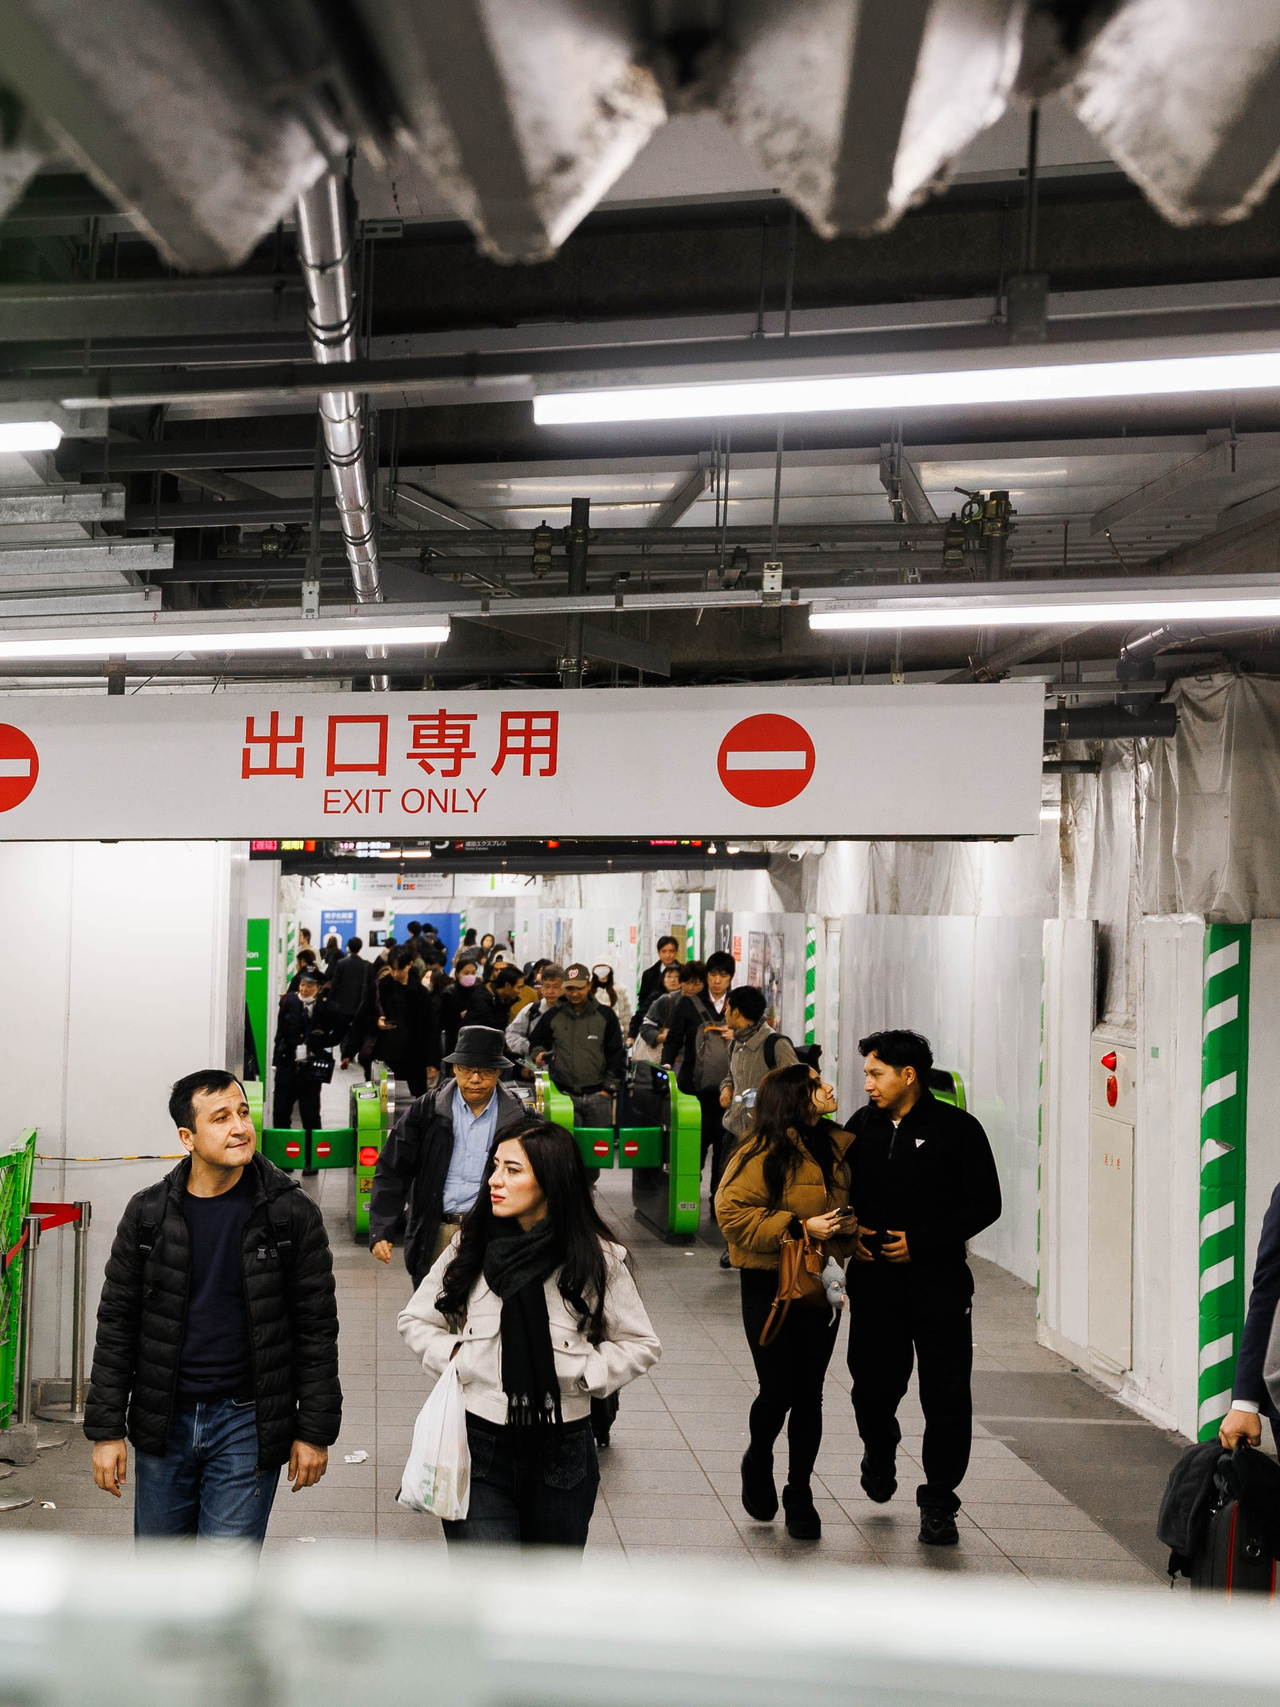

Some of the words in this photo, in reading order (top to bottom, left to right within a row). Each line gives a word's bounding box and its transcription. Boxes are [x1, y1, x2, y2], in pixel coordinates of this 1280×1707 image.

[241, 708, 560, 779] 出口専用
[323, 788, 392, 814] EXIT
[400, 787, 488, 814] ONLY
